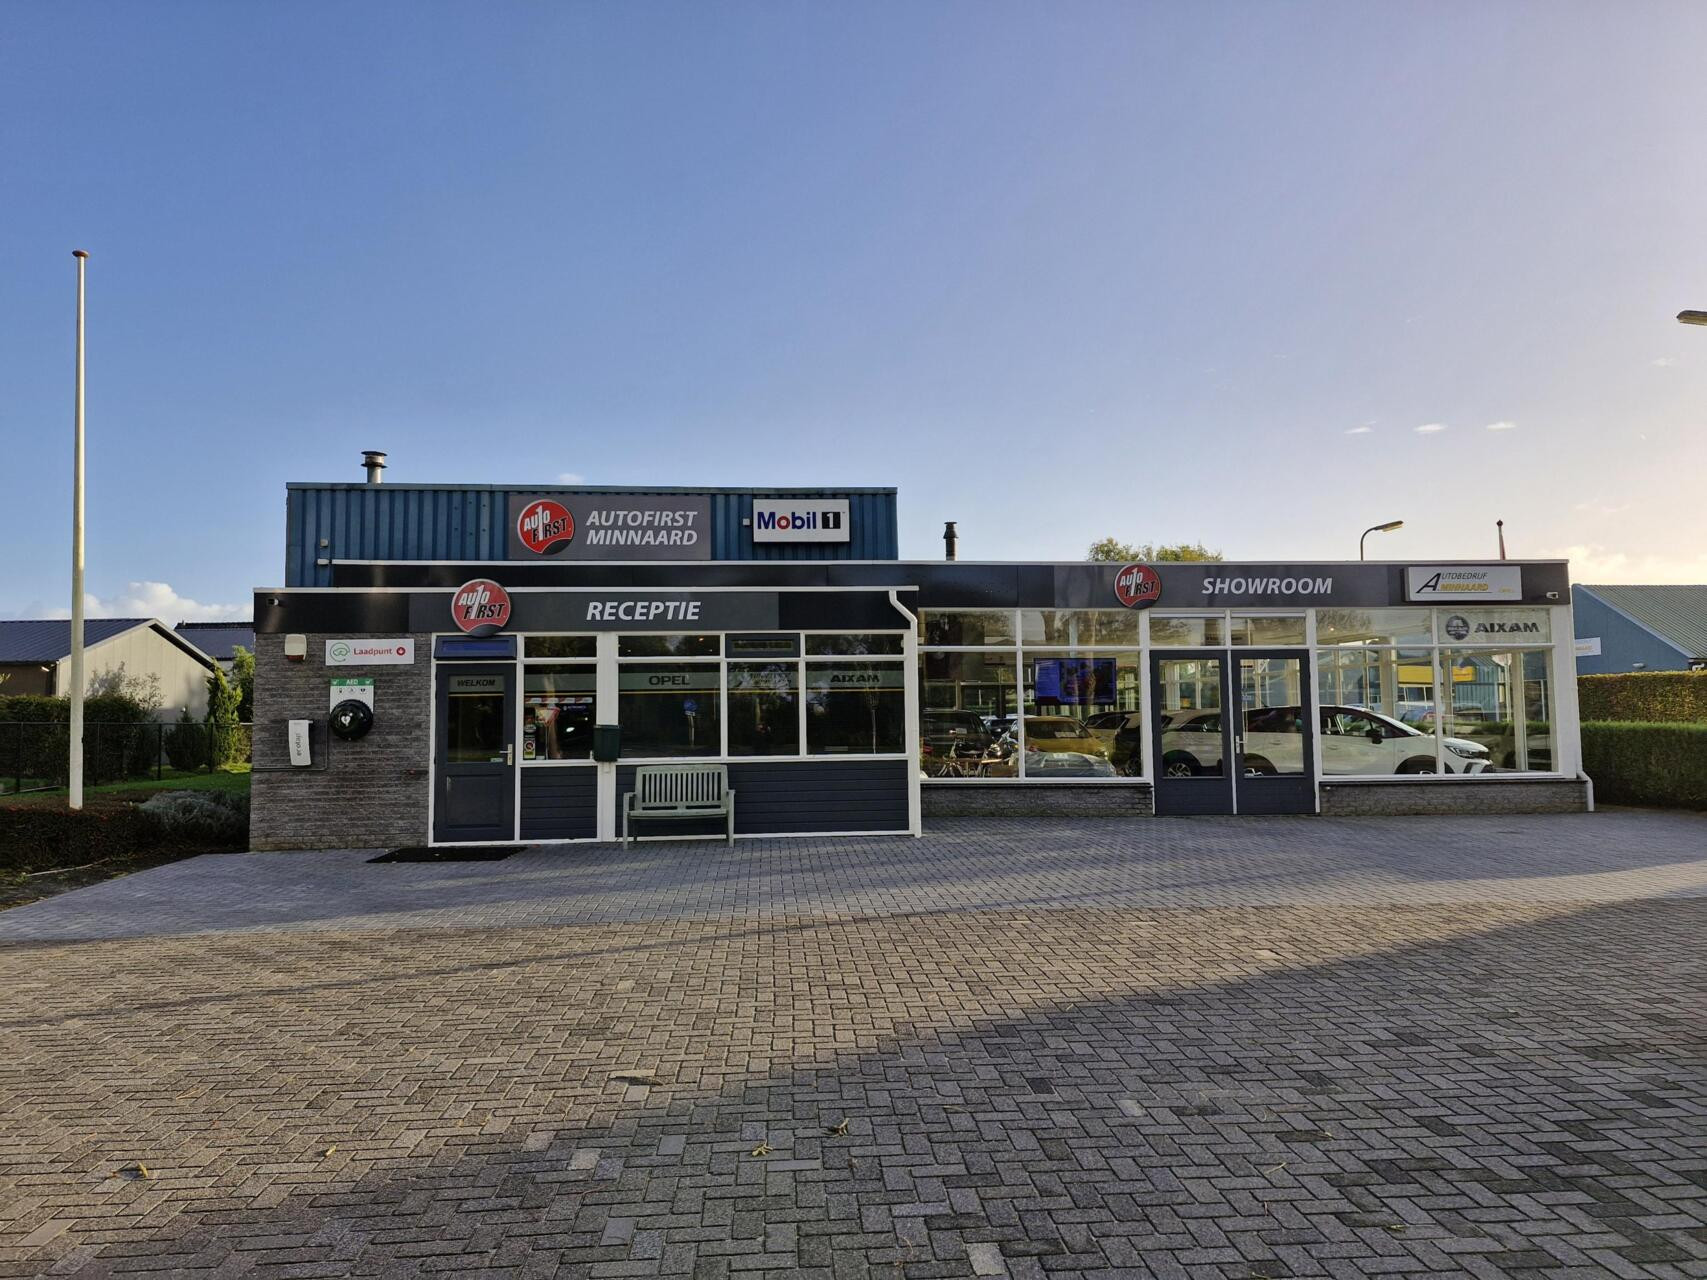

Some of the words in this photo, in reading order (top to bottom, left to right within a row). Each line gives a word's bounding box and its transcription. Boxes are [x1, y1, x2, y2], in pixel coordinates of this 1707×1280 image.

[586, 510, 698, 526] AUTOFIRST
[757, 512, 817, 530] Mobil
[586, 530, 698, 545] MINNAARD
[1201, 577, 1333, 595] SHOWROOM
[586, 601, 701, 620] RECEPTIE
[1474, 622, 1541, 633] AIXAM
[353, 647, 392, 656] Laadpunt
[457, 679, 496, 687] WELKOM
[648, 674, 691, 686] OPEL
[830, 673, 880, 684] AIXAM
